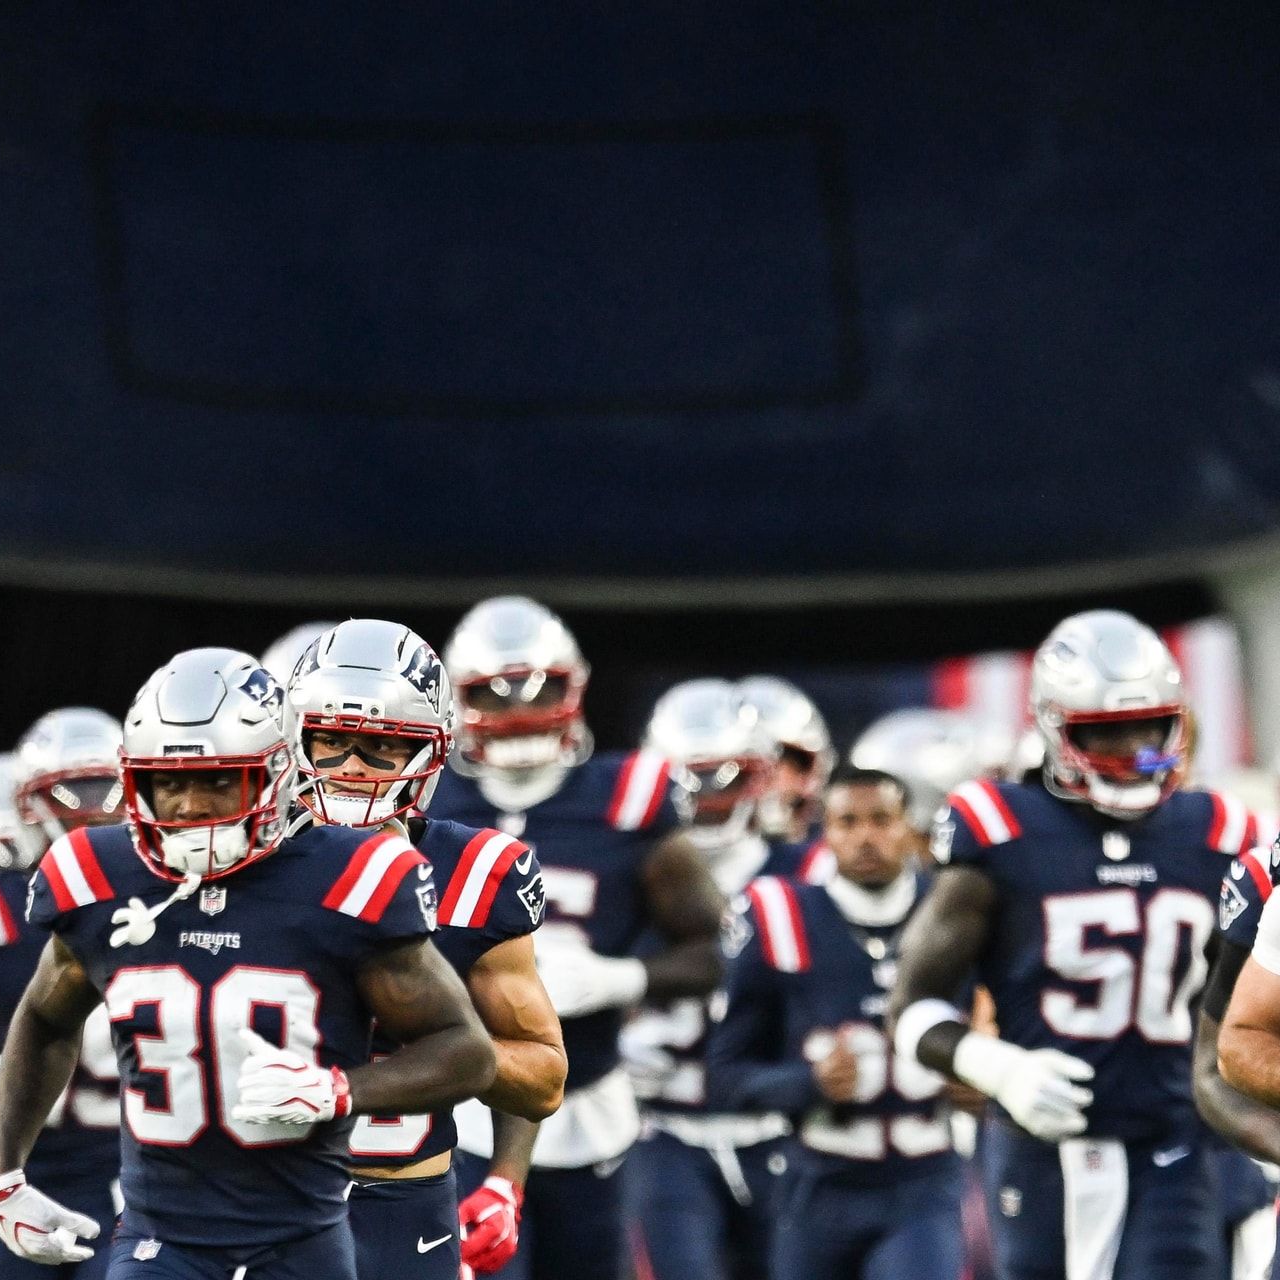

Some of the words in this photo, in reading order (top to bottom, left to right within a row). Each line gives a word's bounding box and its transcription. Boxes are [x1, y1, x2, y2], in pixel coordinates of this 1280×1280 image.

[179, 931, 241, 949] PATRIOTS
[1040, 886, 1216, 1046] 50
[105, 964, 323, 1148] 30
